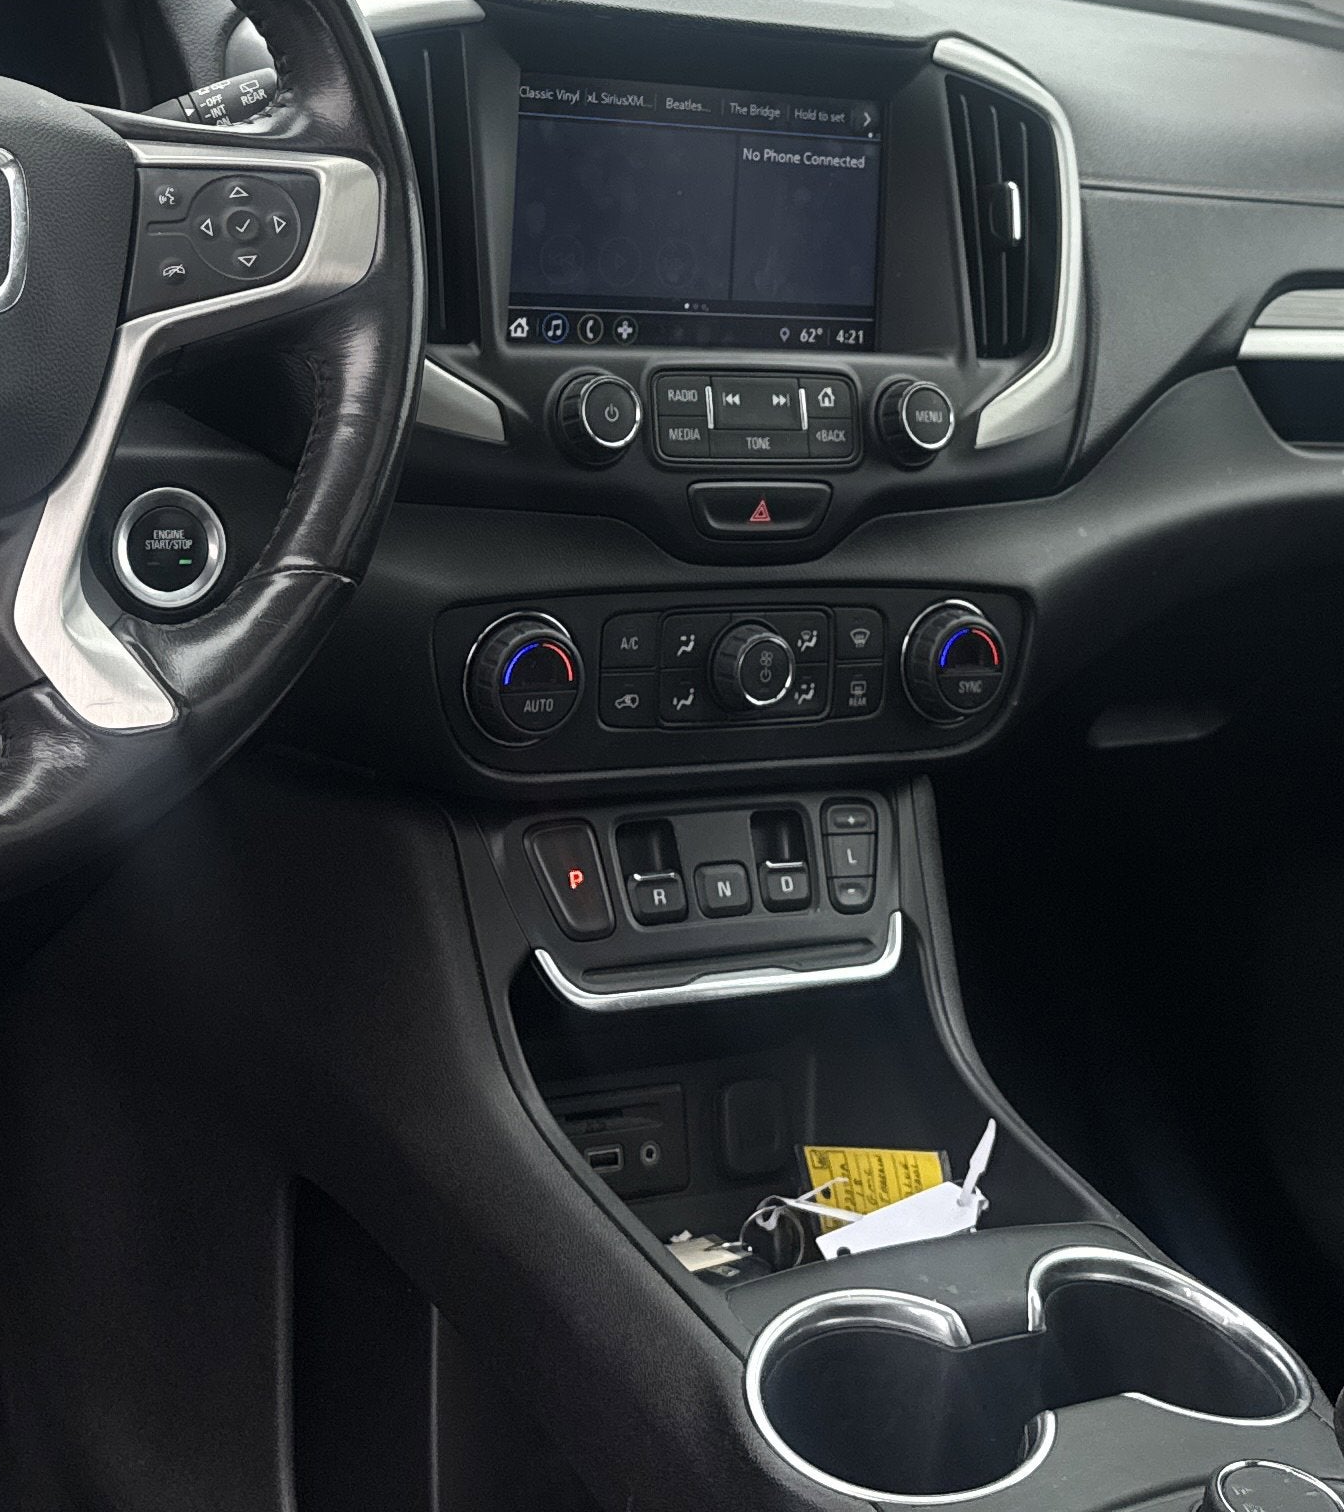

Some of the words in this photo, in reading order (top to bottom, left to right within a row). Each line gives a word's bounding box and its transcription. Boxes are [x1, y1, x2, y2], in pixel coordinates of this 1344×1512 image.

[206, 94, 222, 108] OFF
[240, 89, 268, 107] REAR
[519, 86, 554, 101] Classic
[556, 89, 581, 104] Vinyl
[210, 104, 227, 118] INT
[729, 102, 748, 116] The
[749, 104, 782, 120] Bridge
[794, 108, 816, 122] Hold
[817, 110, 829, 122] to
[829, 112, 847, 124] set
[742, 147, 762, 162] No
[763, 149, 802, 165] Phone
[802, 152, 866, 169] Connected
[799, 327, 824, 345] 62°
[835, 329, 865, 345] 4:21
[667, 387, 699, 404] RADIO
[914, 410, 943, 425] MENU
[668, 427, 701, 443] MEDIA
[745, 436, 771, 451] TONE
[821, 427, 847, 444] BACK
[153, 529, 185, 539] ENGINE
[145, 539, 193, 550] START/STOP
[619, 635, 640, 652] A/C
[957, 679, 983, 696] SYNC
[523, 696, 555, 714] AUTO
[848, 697, 867, 707] REAR
[847, 848, 858, 864] L
[567, 869, 584, 889] P
[780, 874, 795, 893] D
[653, 887, 668, 907] R
[718, 879, 733, 898] N
